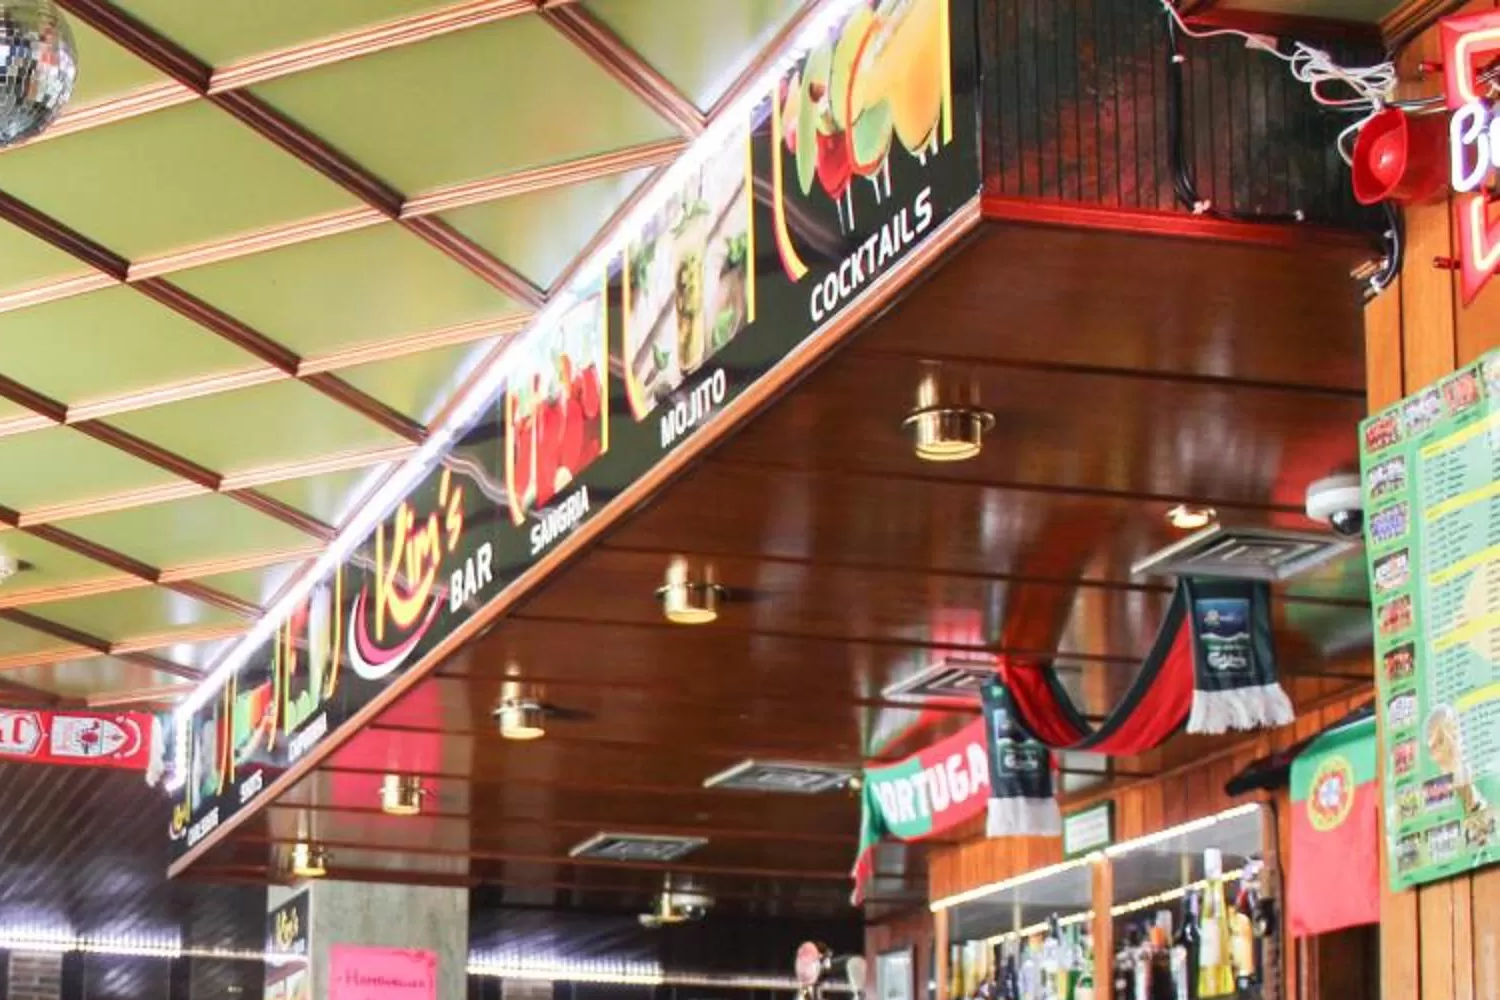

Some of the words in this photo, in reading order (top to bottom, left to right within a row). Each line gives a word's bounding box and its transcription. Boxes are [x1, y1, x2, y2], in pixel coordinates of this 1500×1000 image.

[809, 186, 933, 323] COCKTAILS
[660, 367, 726, 449] MOJITO
[375, 468, 464, 642] Kim's
[530, 485, 591, 556] SANGRIA
[449, 541, 494, 613] BAR
[870, 742, 990, 825] ORTUGA
